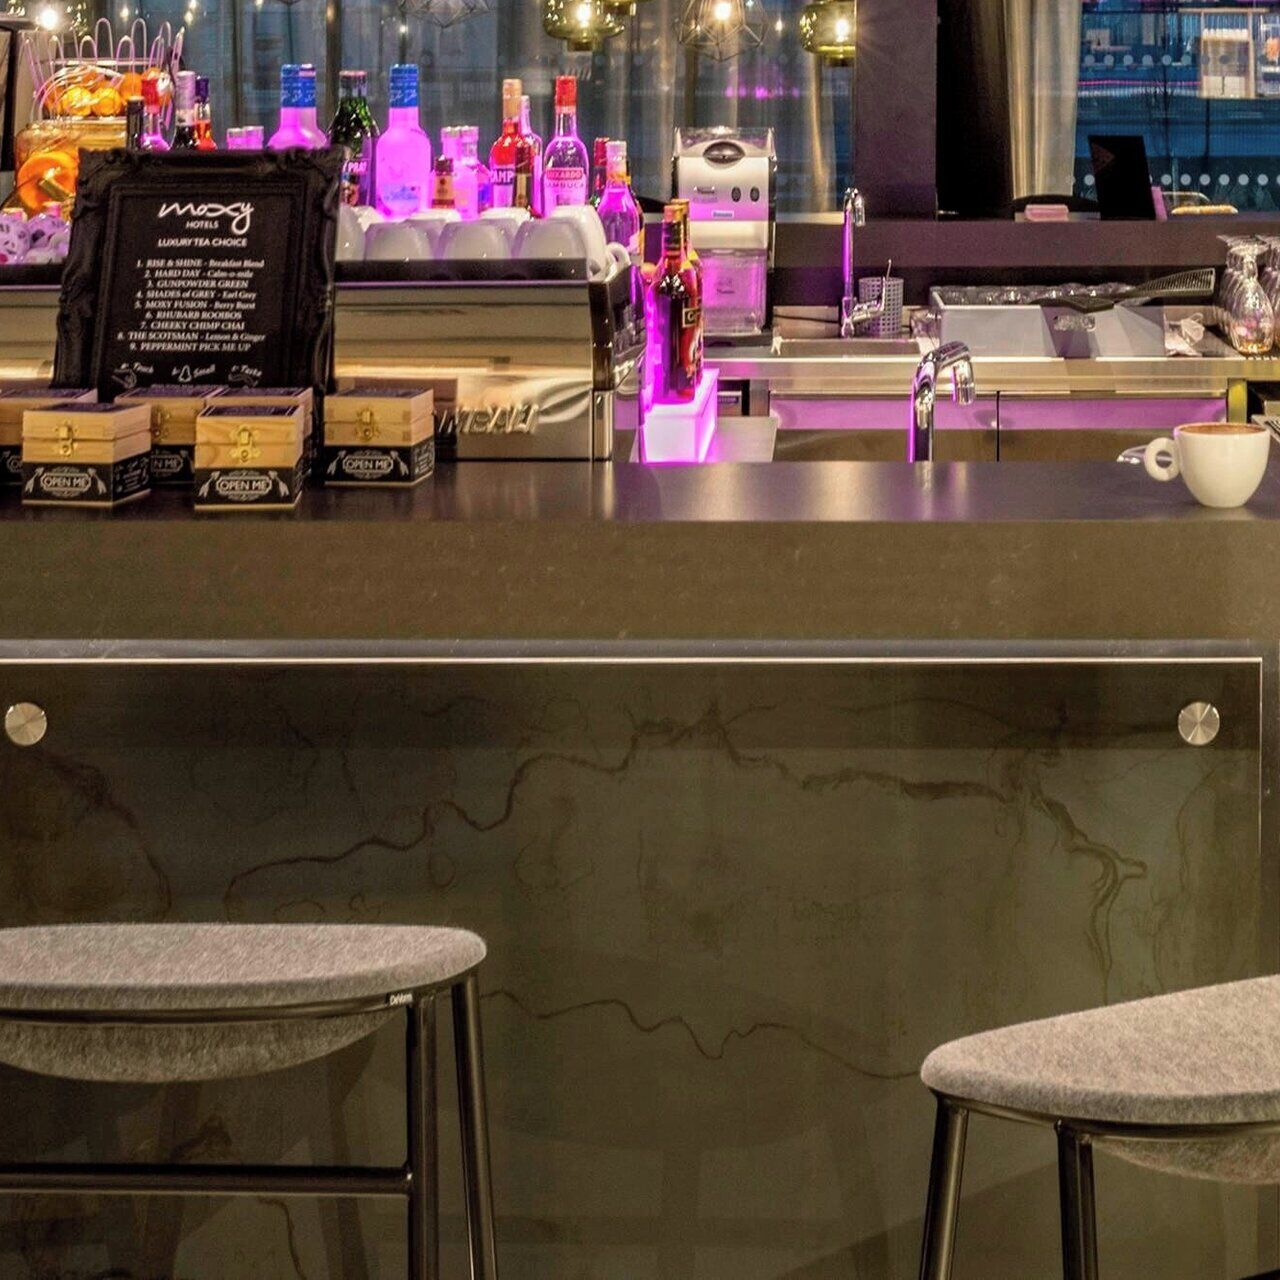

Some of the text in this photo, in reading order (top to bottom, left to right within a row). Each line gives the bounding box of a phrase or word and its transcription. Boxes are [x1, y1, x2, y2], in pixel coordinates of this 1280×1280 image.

[185, 221, 219, 229] HOTELS
[157, 238, 248, 247] LUXURY TEA CHOICE
[175, 259, 203, 268] SHINE
[155, 269, 181, 278] HARD
[182, 269, 202, 278] DAY
[156, 280, 217, 288] GUNPOWDER
[218, 280, 249, 288] GREEN
[146, 290, 181, 299] SHADES
[173, 301, 208, 309] FUSION
[128, 331, 147, 340] THE
[347, 459, 389, 469] OPEN ME
[43, 477, 89, 487] OPEN ME
[222, 480, 268, 490] OPEN ME
